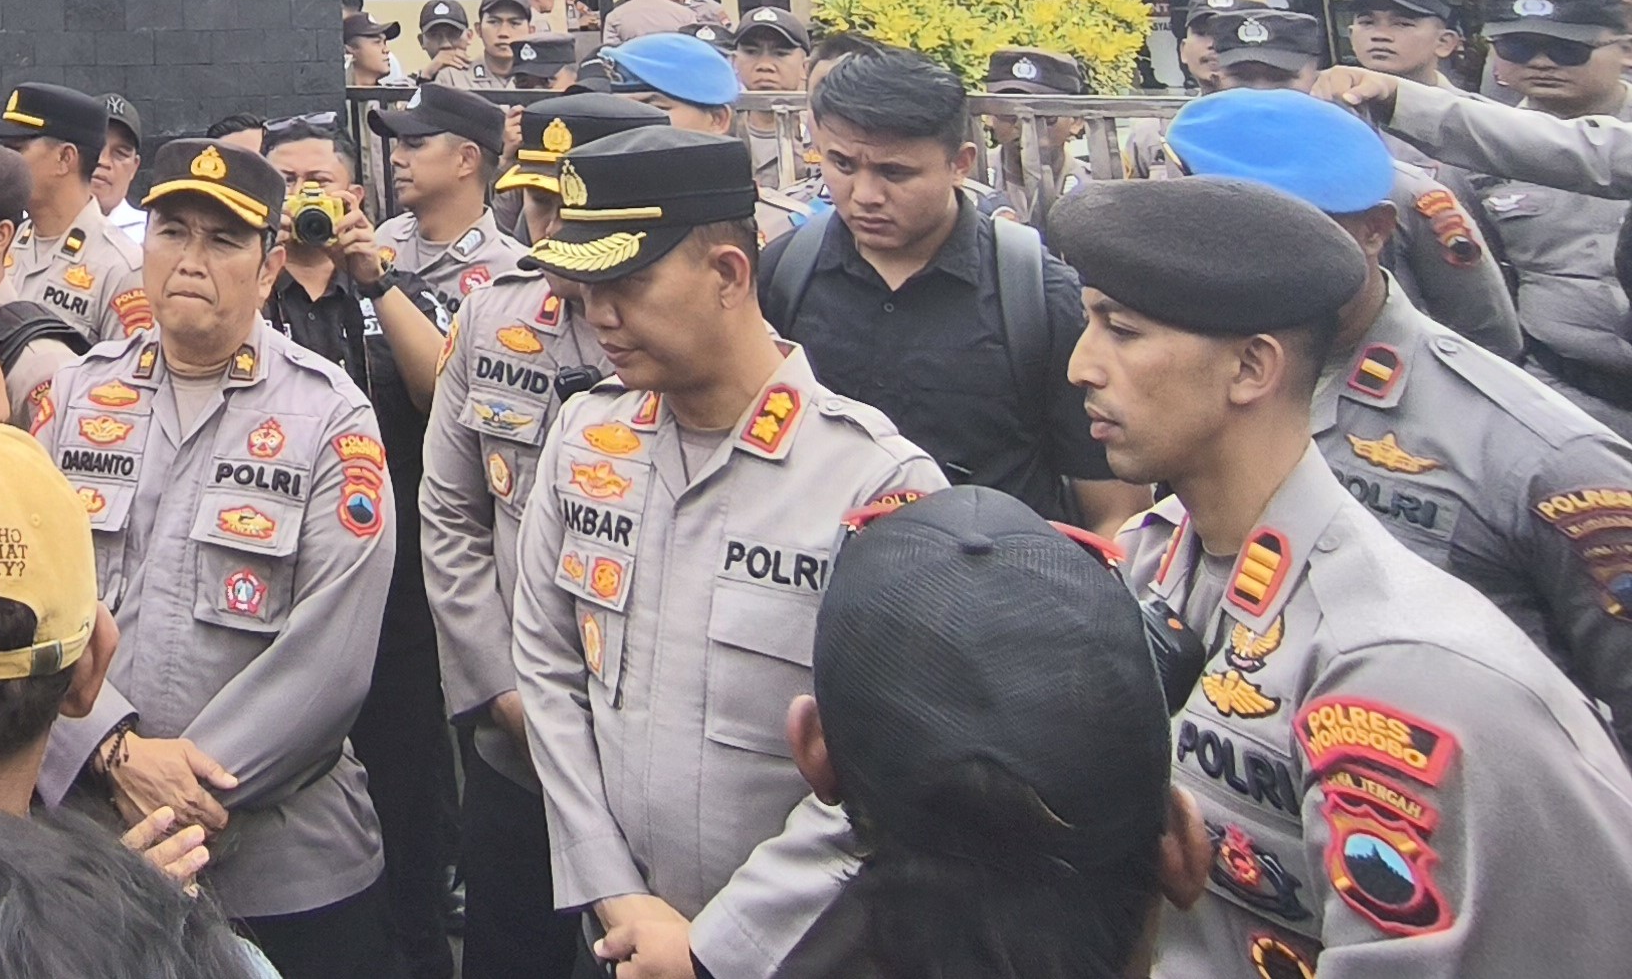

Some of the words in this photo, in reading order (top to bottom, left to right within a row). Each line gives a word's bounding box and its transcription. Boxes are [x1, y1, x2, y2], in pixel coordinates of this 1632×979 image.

[43, 286, 89, 315] POLRI
[476, 356, 549, 394] DAVID
[62, 450, 134, 476] DARIANTO
[215, 462, 301, 497] POLRI
[564, 498, 633, 547] AKBAR
[1537, 489, 1632, 519] POLRES
[724, 541, 828, 591] POLRI
[1308, 703, 1414, 745] POLRES
[1308, 724, 1428, 769] WONOSOBO
[1177, 719, 1300, 817] POLRI
